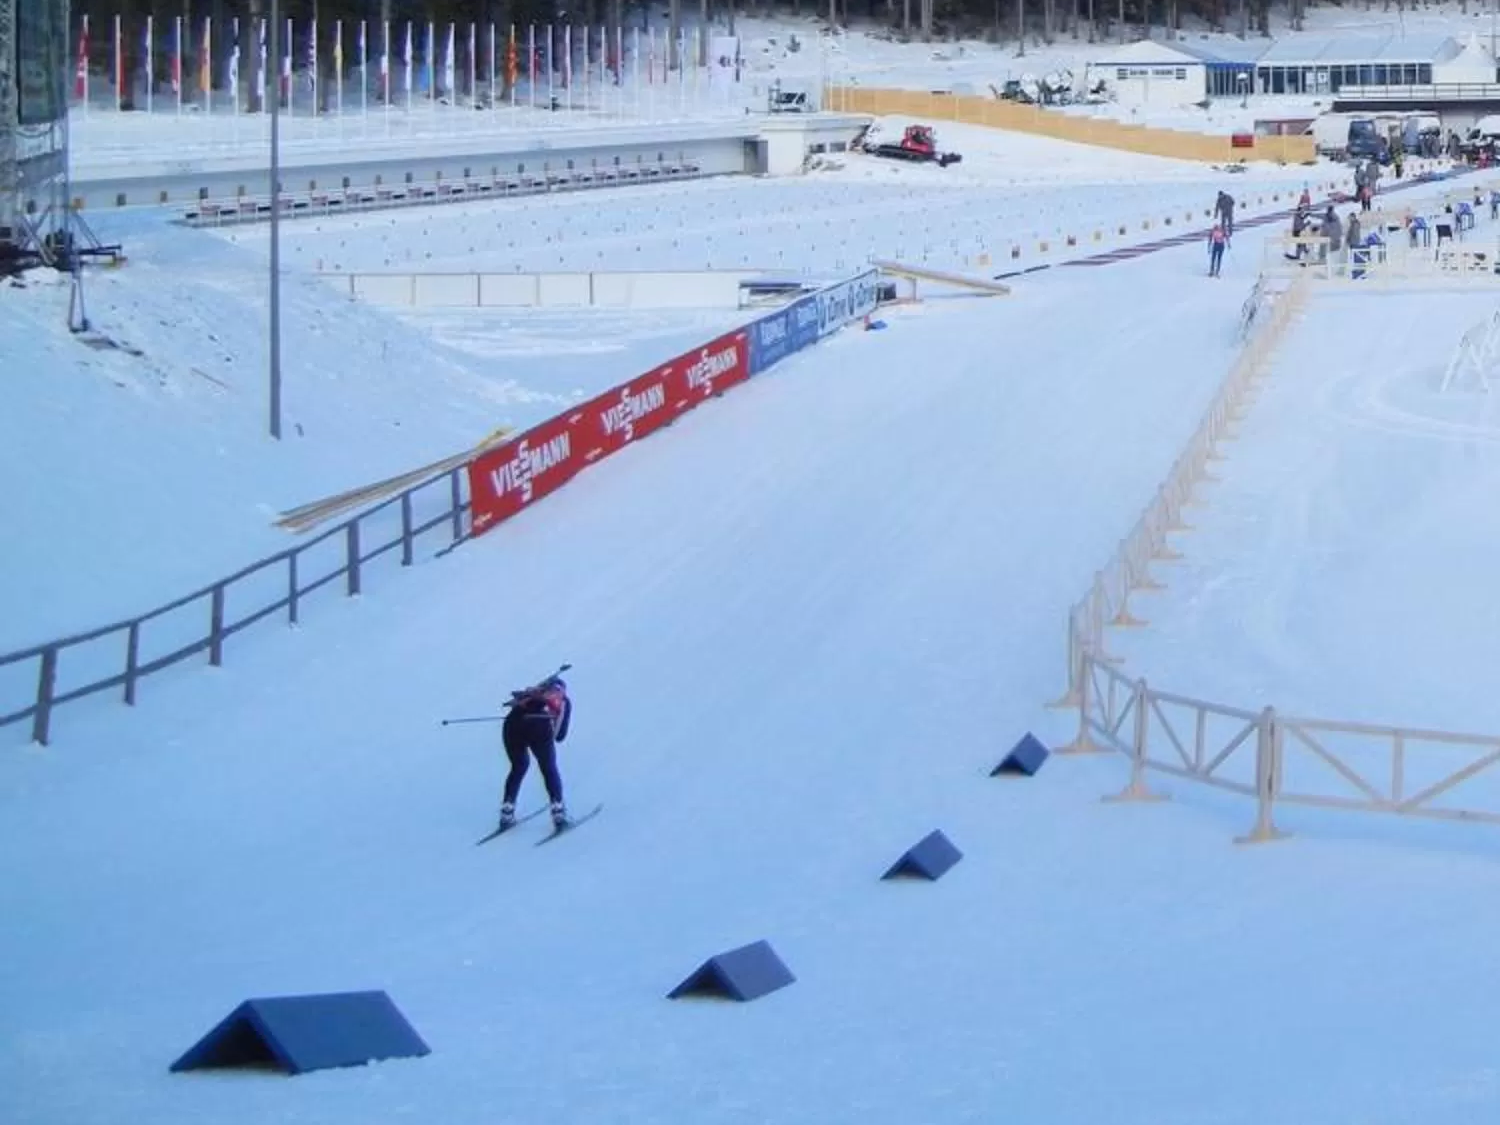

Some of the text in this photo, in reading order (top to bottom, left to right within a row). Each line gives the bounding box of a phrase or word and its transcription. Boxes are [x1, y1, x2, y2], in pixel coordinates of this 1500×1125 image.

[686, 346, 739, 396] VIESSMANN
[600, 383, 666, 441] VIESSMANN
[491, 430, 571, 503] VIESSMANN
